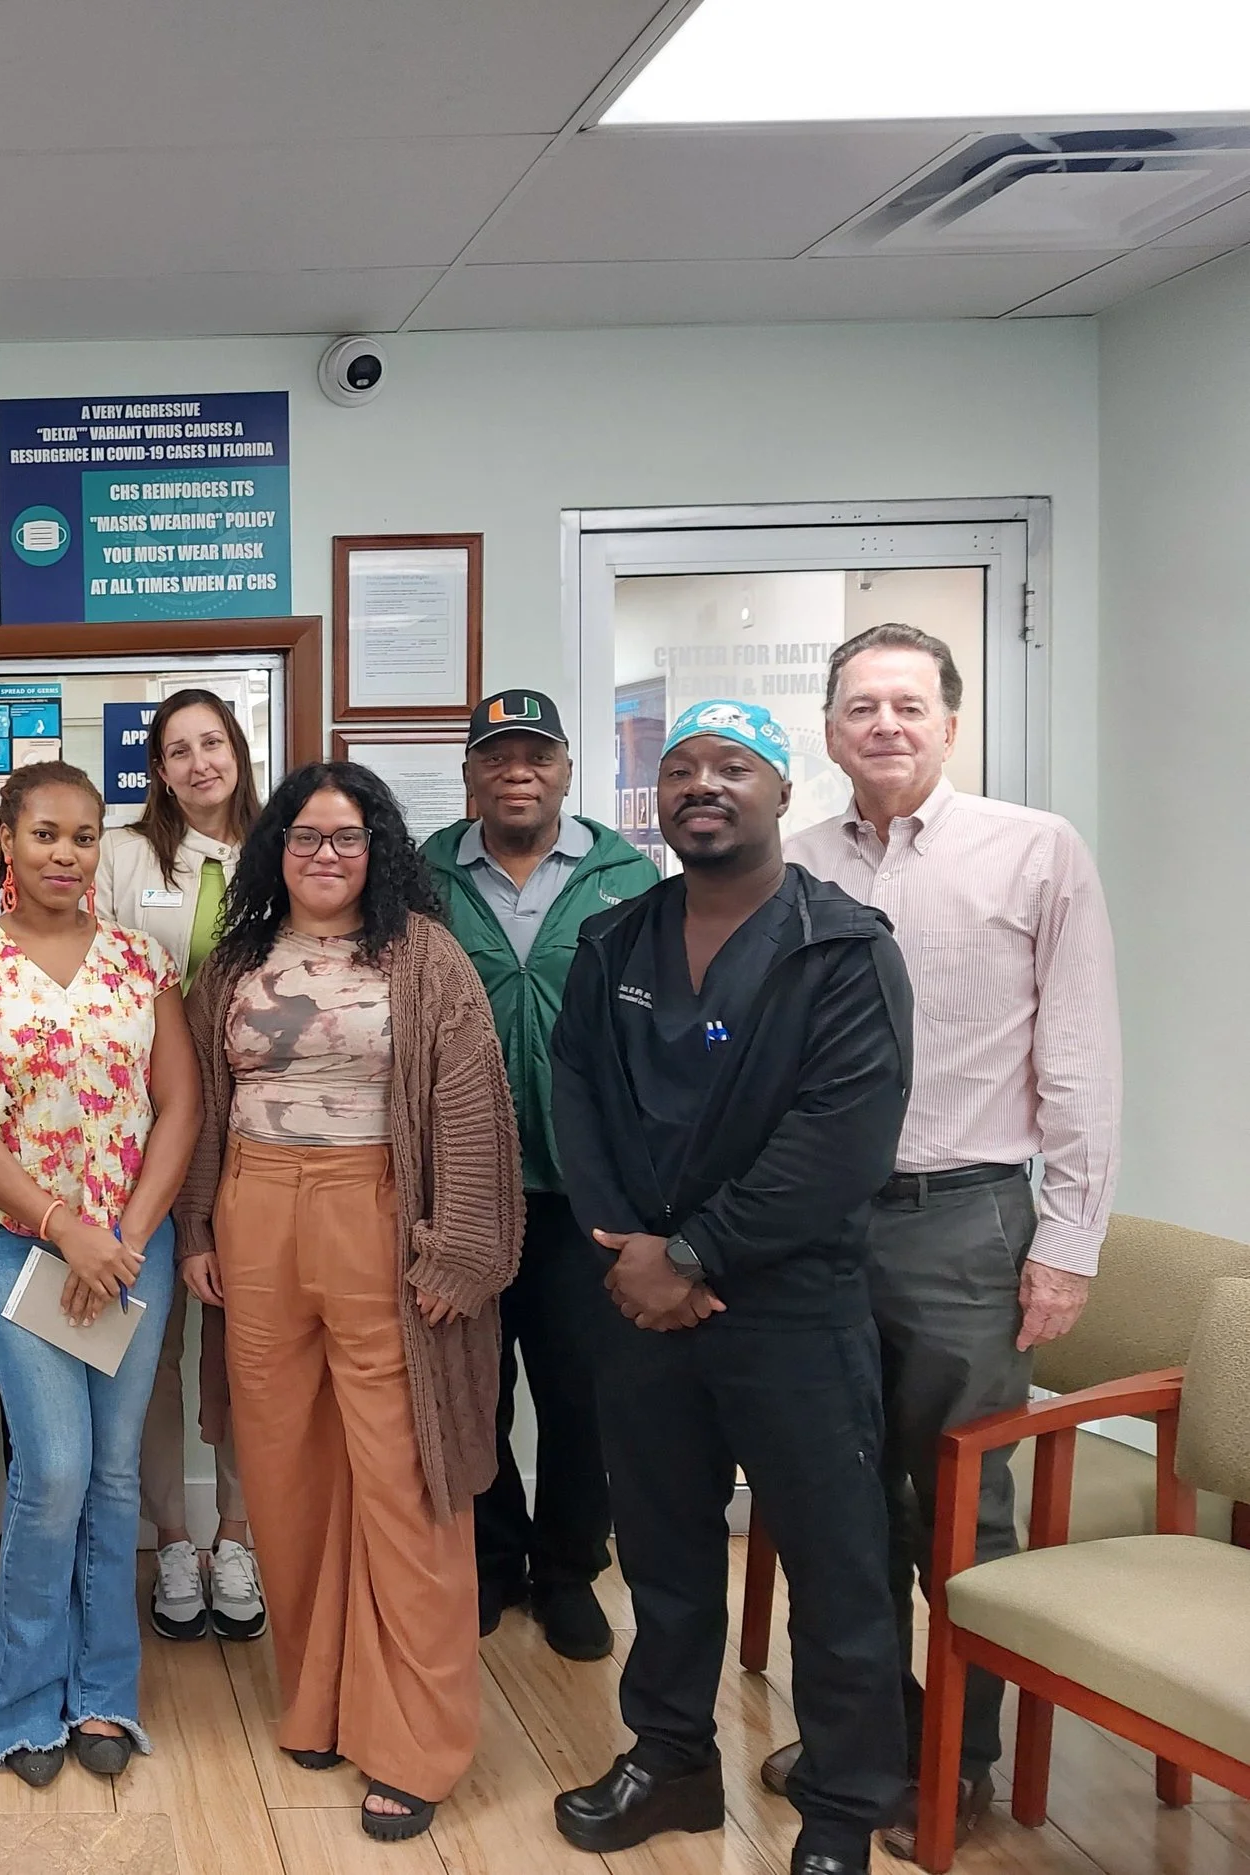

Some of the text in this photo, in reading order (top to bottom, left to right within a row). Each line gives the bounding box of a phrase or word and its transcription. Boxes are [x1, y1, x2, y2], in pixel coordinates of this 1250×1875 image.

[81, 402, 201, 420] A VERY AGGRESSIVE
[89, 425, 143, 441] VARIANT
[143, 423, 183, 440] VIRUS
[184, 422, 233, 438] CAUSES
[234, 421, 244, 436] A
[10, 442, 274, 464] RESURGENCE IN COVID-19 CASES IN FLORIDA
[110, 480, 254, 501] CHS REINFORCES ITS
[225, 511, 275, 528] POLICY
[103, 542, 264, 564] YOU MUST WEAR MASK
[90, 573, 277, 595] AT ALL TIMES WHEN AT CHS
[653, 645, 727, 668] CENTER
[732, 643, 770, 667] FOR
[0, 687, 26, 695] SPREAD
[666, 674, 737, 697] HEALTH
[742, 677, 758, 696] &
